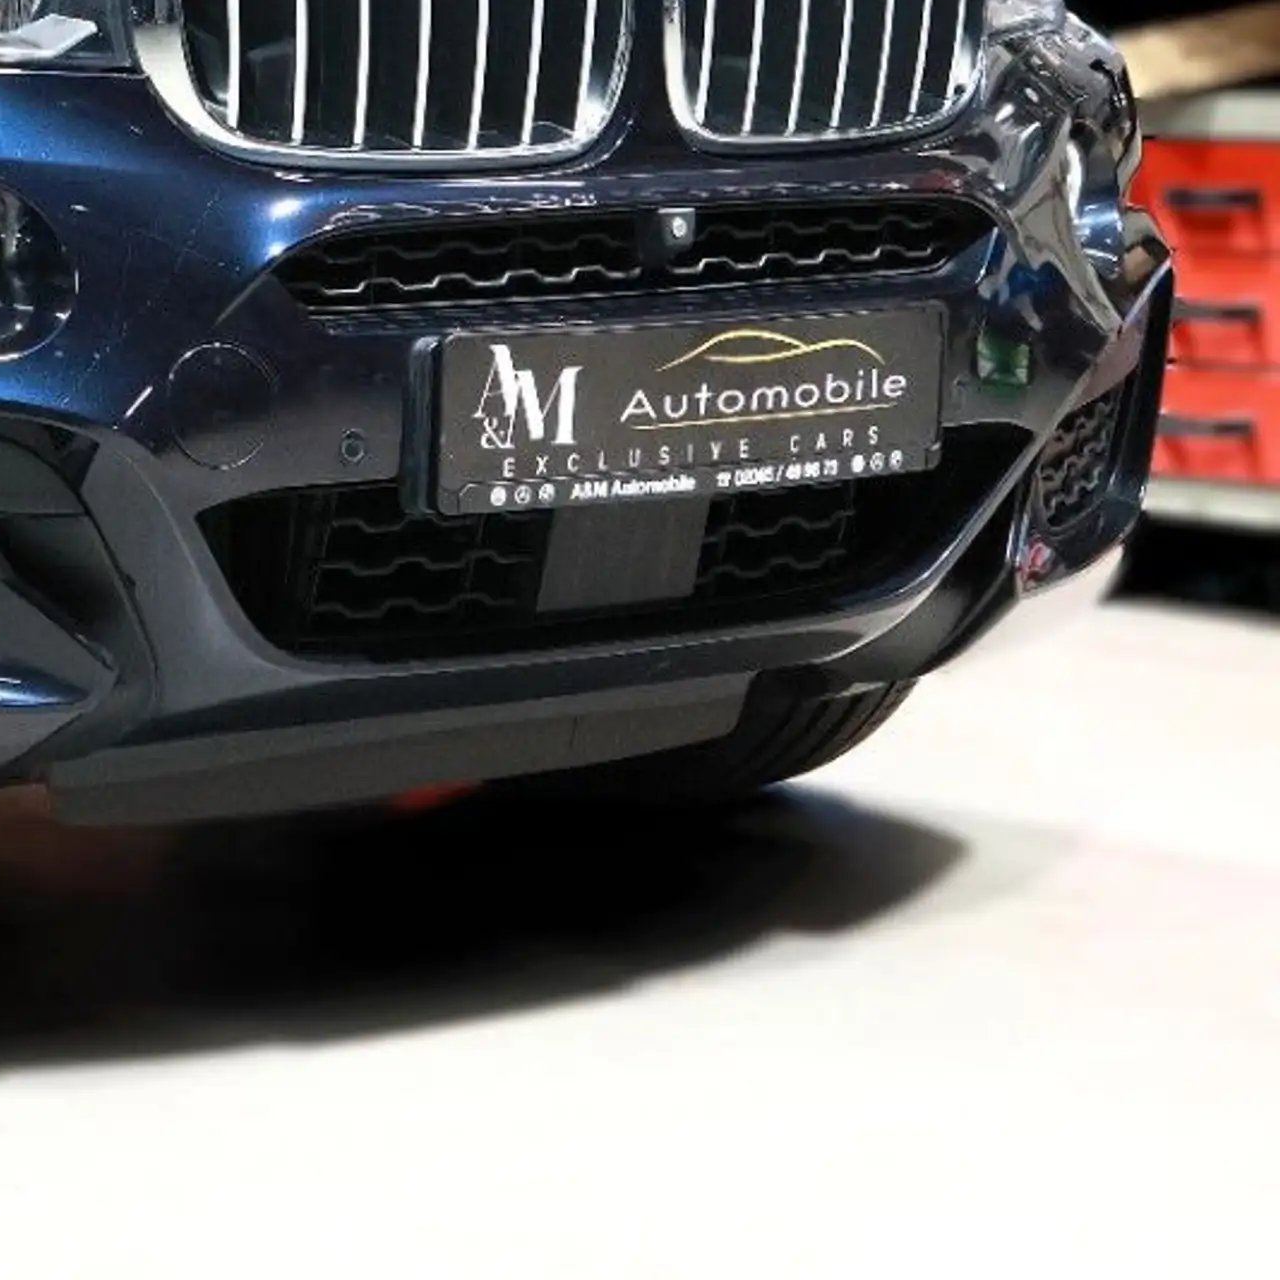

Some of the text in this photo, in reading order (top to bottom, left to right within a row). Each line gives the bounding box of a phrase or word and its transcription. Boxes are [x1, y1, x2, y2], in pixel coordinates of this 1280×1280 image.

[620, 368, 907, 423] Automobile
[502, 425, 879, 478] EXCLUSIVE CARS
[610, 474, 696, 496] Automobile
